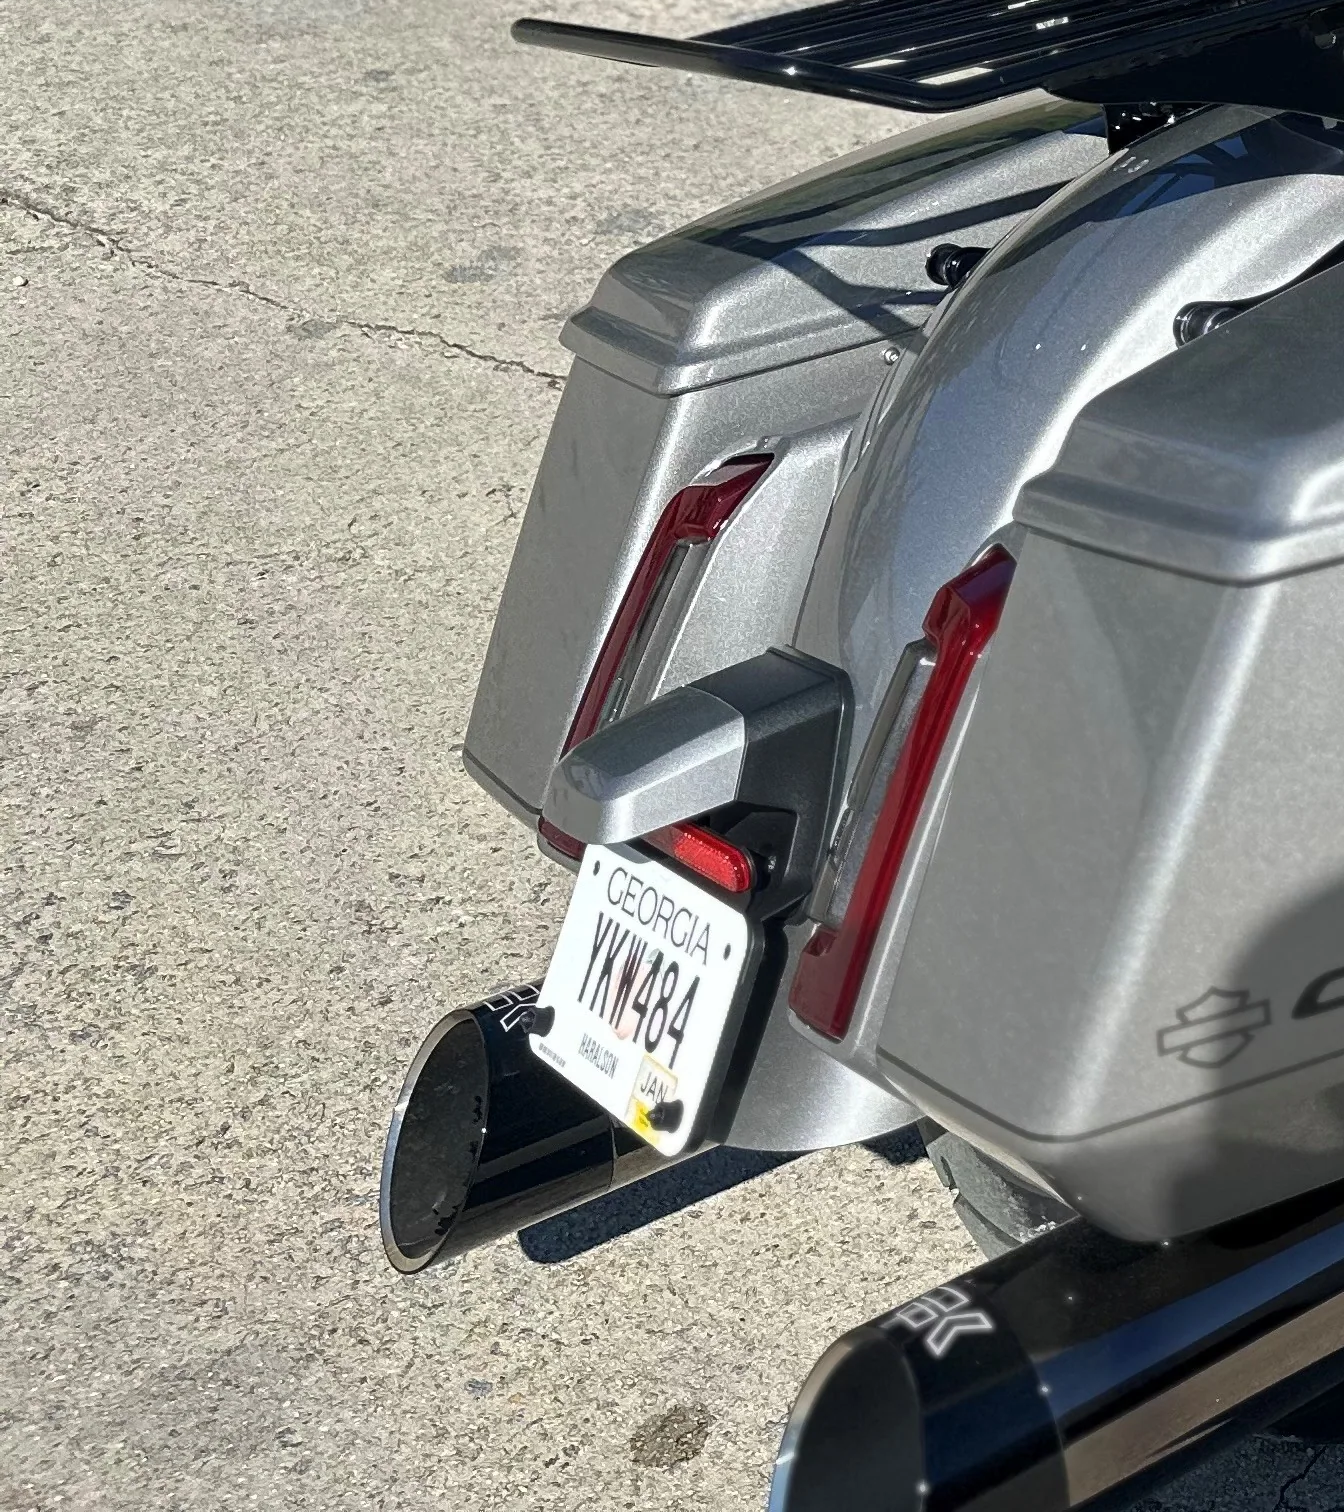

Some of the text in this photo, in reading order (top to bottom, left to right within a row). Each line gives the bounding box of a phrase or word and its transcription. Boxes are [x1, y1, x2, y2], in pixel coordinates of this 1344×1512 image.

[606, 866, 711, 966] GEORGIA
[577, 910, 701, 1070] YKW484
[640, 1071, 669, 1105] JAN
